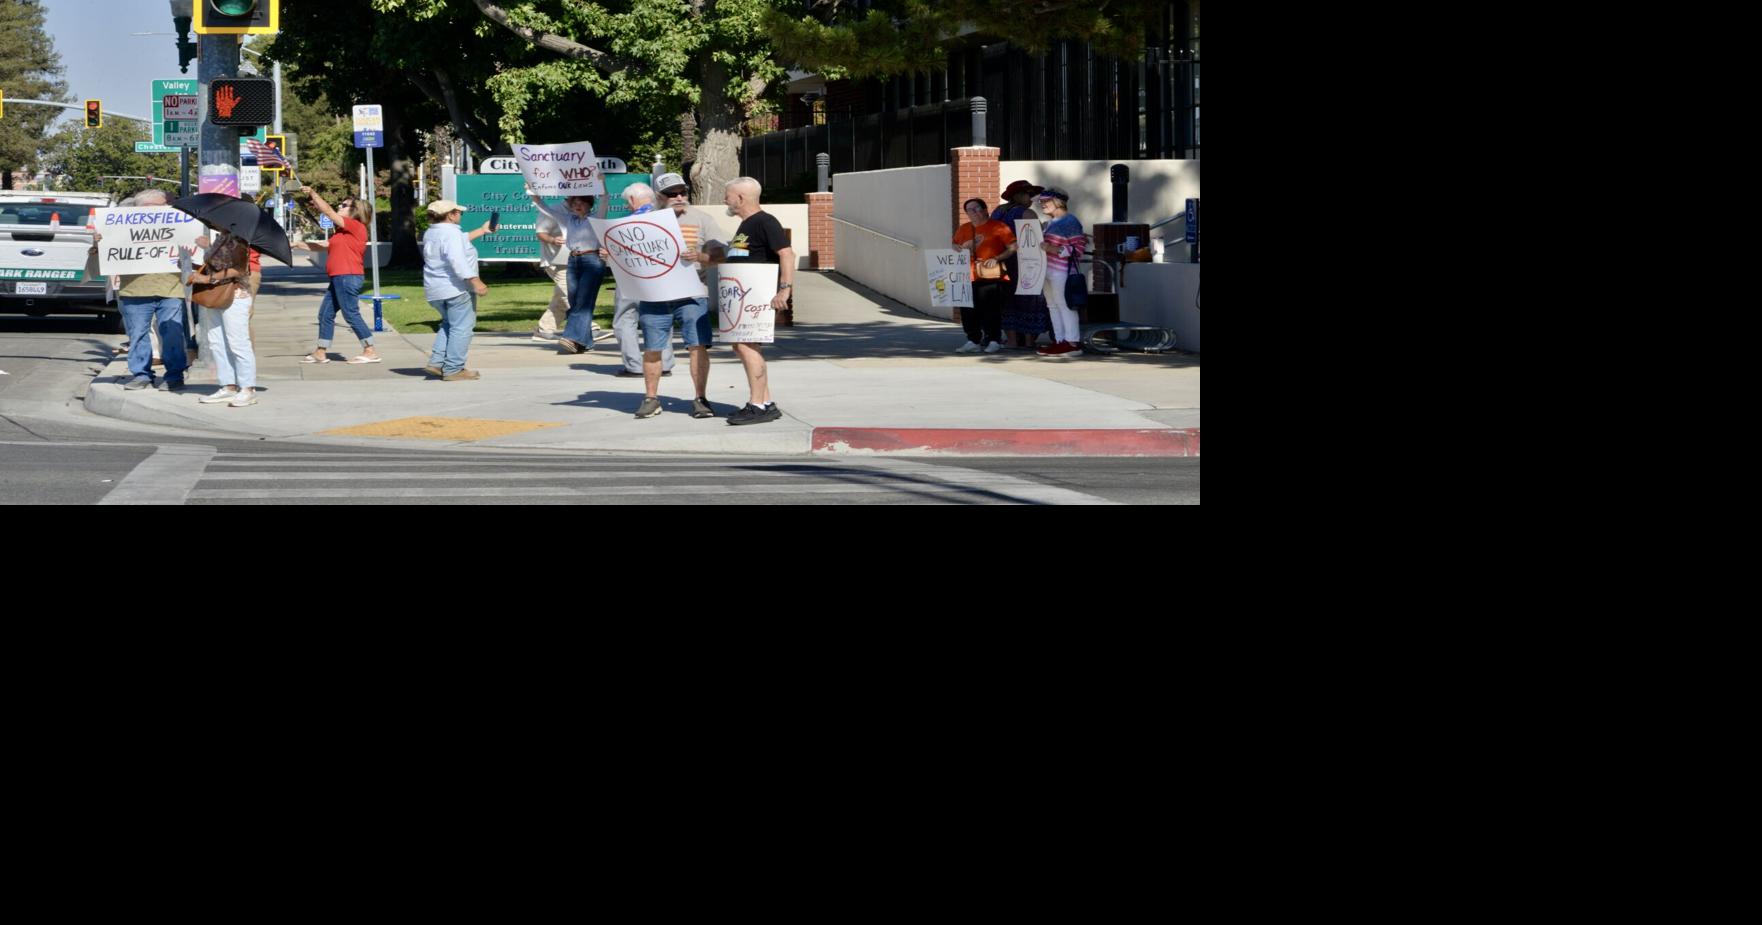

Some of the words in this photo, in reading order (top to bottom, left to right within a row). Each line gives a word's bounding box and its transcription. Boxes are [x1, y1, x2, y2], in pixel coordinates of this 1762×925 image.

[163, 81, 190, 91] Valley
[165, 96, 177, 107] NO
[520, 147, 586, 163] Sanctuary
[490, 160, 520, 171] City
[533, 168, 551, 178] for
[559, 165, 596, 180] WHO?
[105, 212, 195, 226] BAKERSFIELD
[130, 228, 176, 241] WANTS
[618, 226, 645, 243] NO
[495, 245, 536, 254] Traffic
[610, 238, 670, 256] SANCTUARY
[624, 253, 666, 267] CITIES
[937, 254, 954, 265] WE
[25, 270, 76, 279] RANGER
